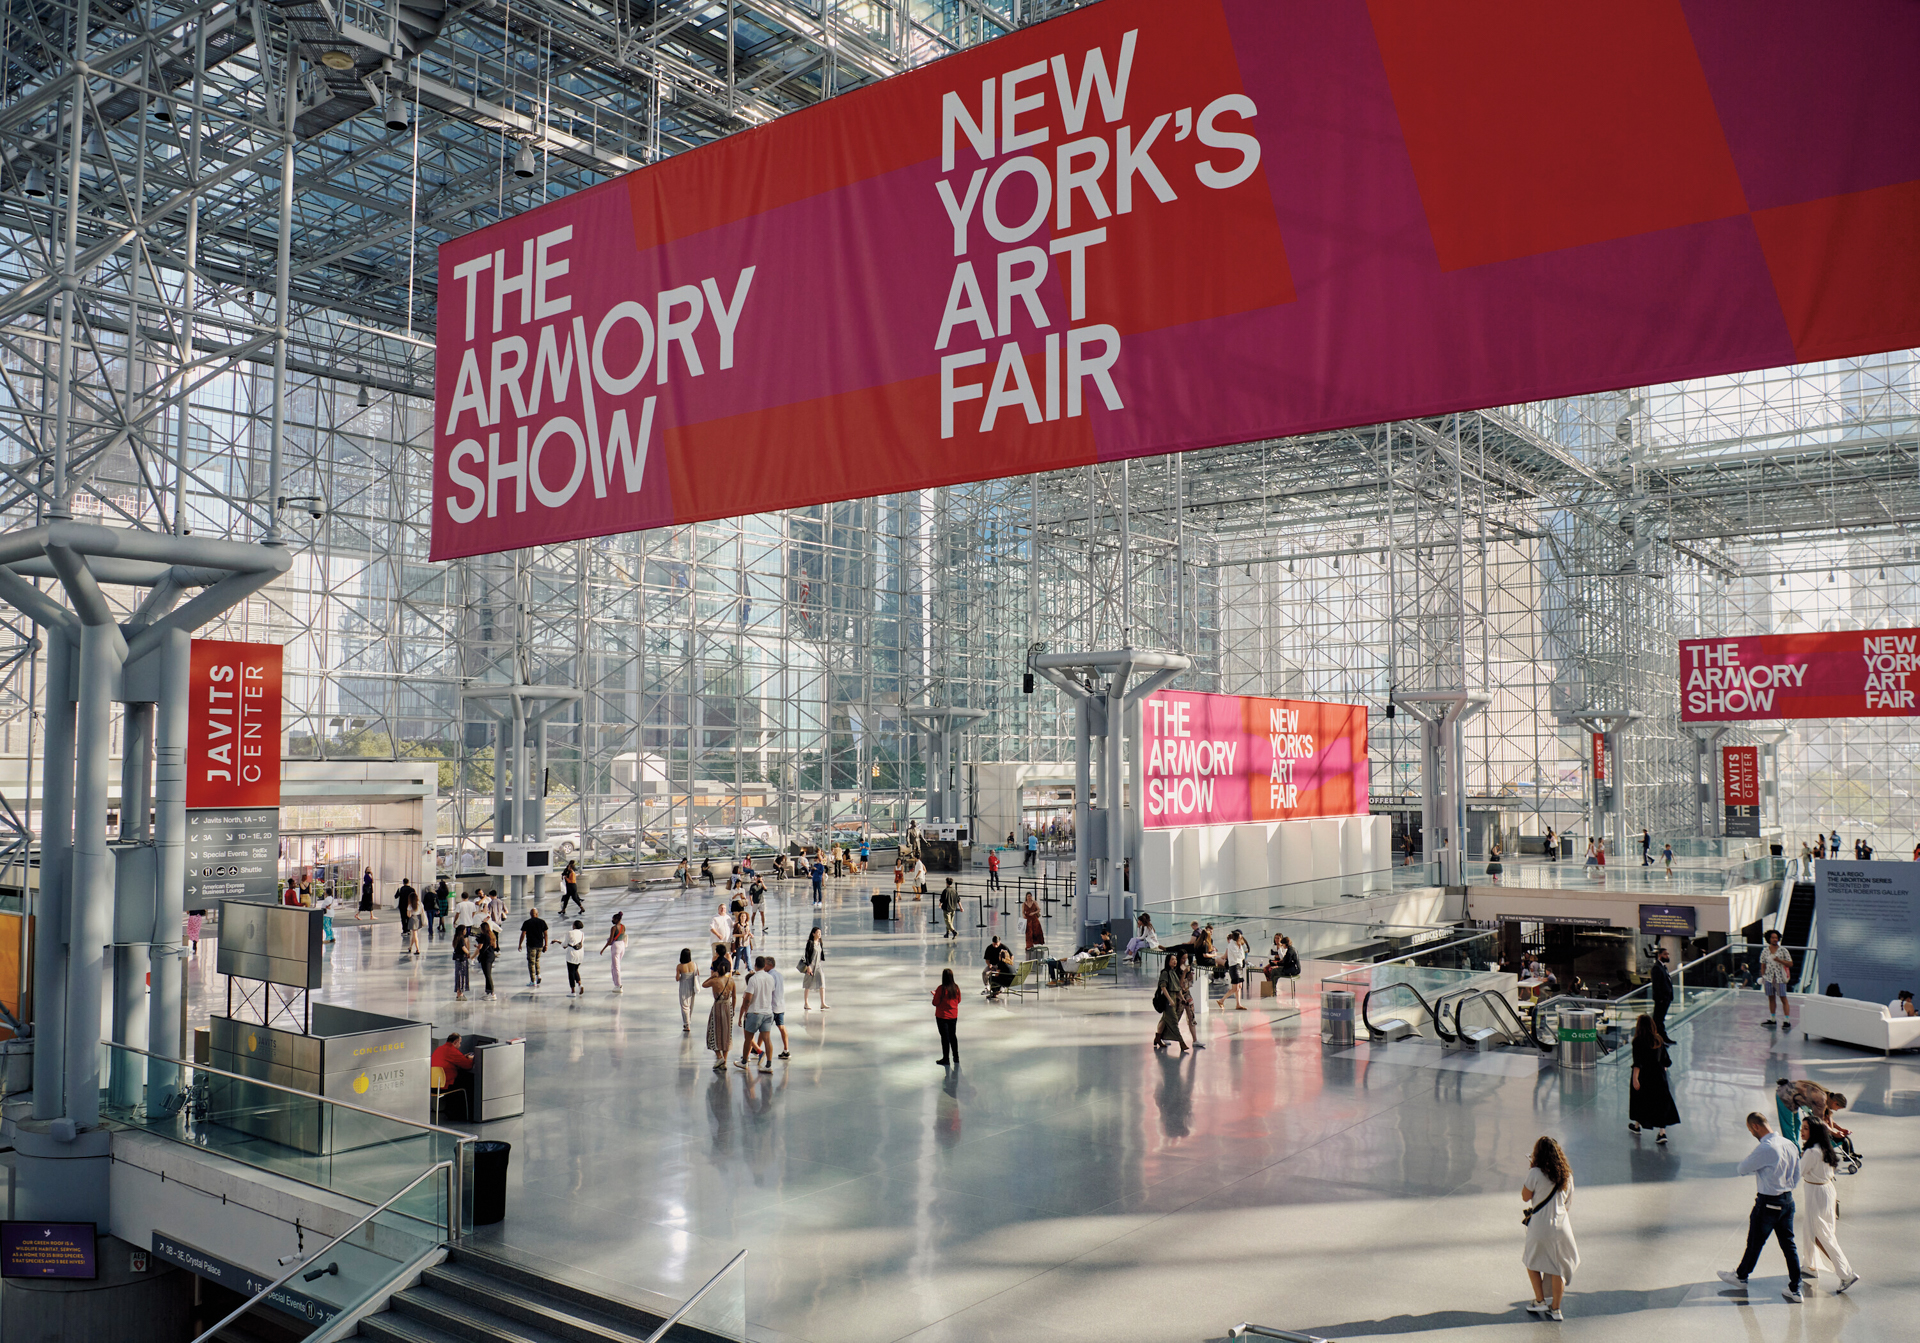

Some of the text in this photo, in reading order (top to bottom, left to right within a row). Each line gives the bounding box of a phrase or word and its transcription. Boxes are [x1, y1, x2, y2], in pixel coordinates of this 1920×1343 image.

[942, 28, 1138, 172] NEW
[934, 93, 1261, 257] YORK'S
[453, 224, 573, 342] THE
[934, 226, 1107, 350] ART
[445, 265, 756, 436] ARMORY
[940, 323, 1124, 440] FAIR
[446, 395, 657, 524] SHOW
[1686, 643, 1740, 668] THE
[1863, 635, 1917, 654] NEW
[1686, 663, 1808, 691] ARMORY
[1864, 672, 1911, 691] ART
[1688, 688, 1775, 714] SHOW
[1865, 690, 1916, 709] FAIR
[207, 665, 234, 782] JAVITS
[243, 666, 264, 782] CENTER
[1148, 699, 1191, 737] THE
[1269, 708, 1299, 733] NEW
[1148, 739, 1237, 775] ARMORY
[1269, 734, 1314, 758] YORK'S
[1269, 759, 1295, 783] ART
[1729, 753, 1741, 797] JAVITS
[1743, 753, 1754, 798] CENTER
[1148, 778, 1215, 816] SHOW
[1270, 784, 1298, 809] FAIR
[1734, 805, 1751, 817] 1E
[252, 832, 262, 840] 1E,
[202, 851, 226, 859] Special
[258, 1036, 277, 1048] JAVITS
[353, 1042, 405, 1056] CONCIERGE
[372, 1069, 405, 1082] JAVITS
[372, 1080, 405, 1092] CENTER
[165, 1245, 173, 1255] 3B
[185, 1253, 203, 1268] Crystal
[203, 1261, 221, 1276] Palace
[265, 1287, 286, 1304] pecial
[286, 1295, 306, 1312] Events
